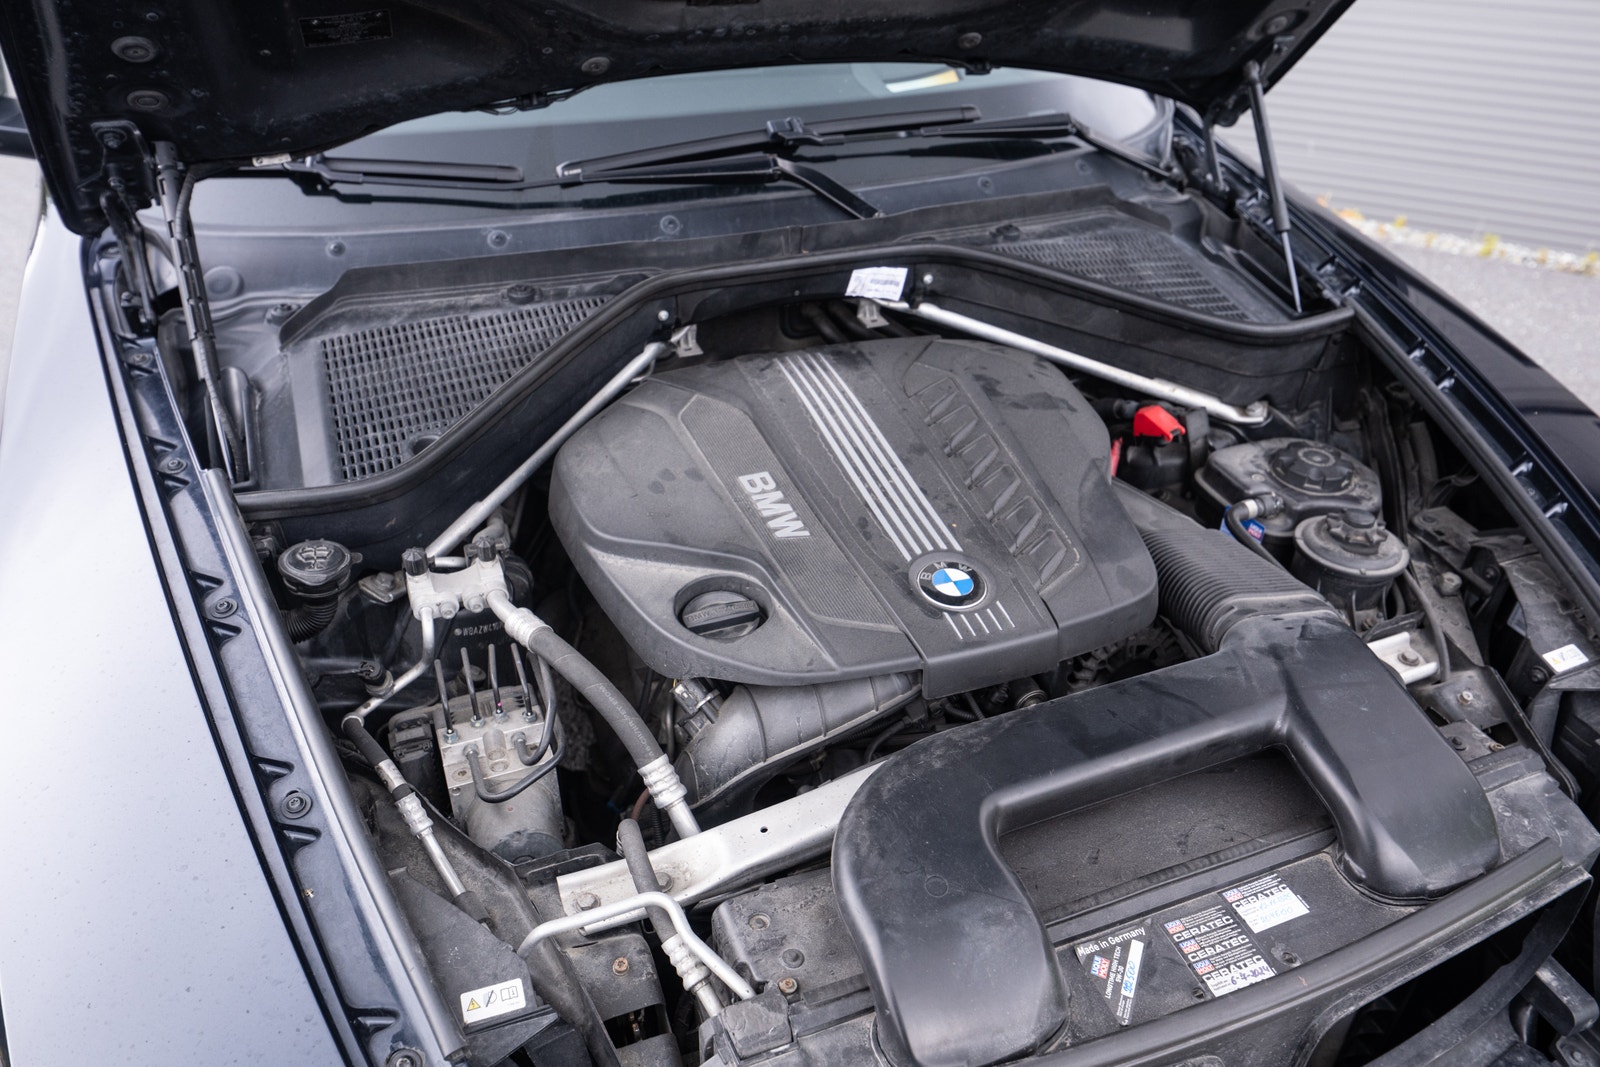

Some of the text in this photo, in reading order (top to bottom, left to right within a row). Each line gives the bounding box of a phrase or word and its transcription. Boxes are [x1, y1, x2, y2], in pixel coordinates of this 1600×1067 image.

[738, 471, 810, 538] BMW
[920, 561, 973, 580] BMW
[1232, 884, 1289, 909] CERATEC
[1077, 927, 1146, 957] Made in Germany
[1173, 915, 1234, 942] CERATEC
[1187, 935, 1250, 962] CERATEC
[1202, 955, 1264, 981] CERATEC
[1104, 971, 1117, 999] LONGTIME
